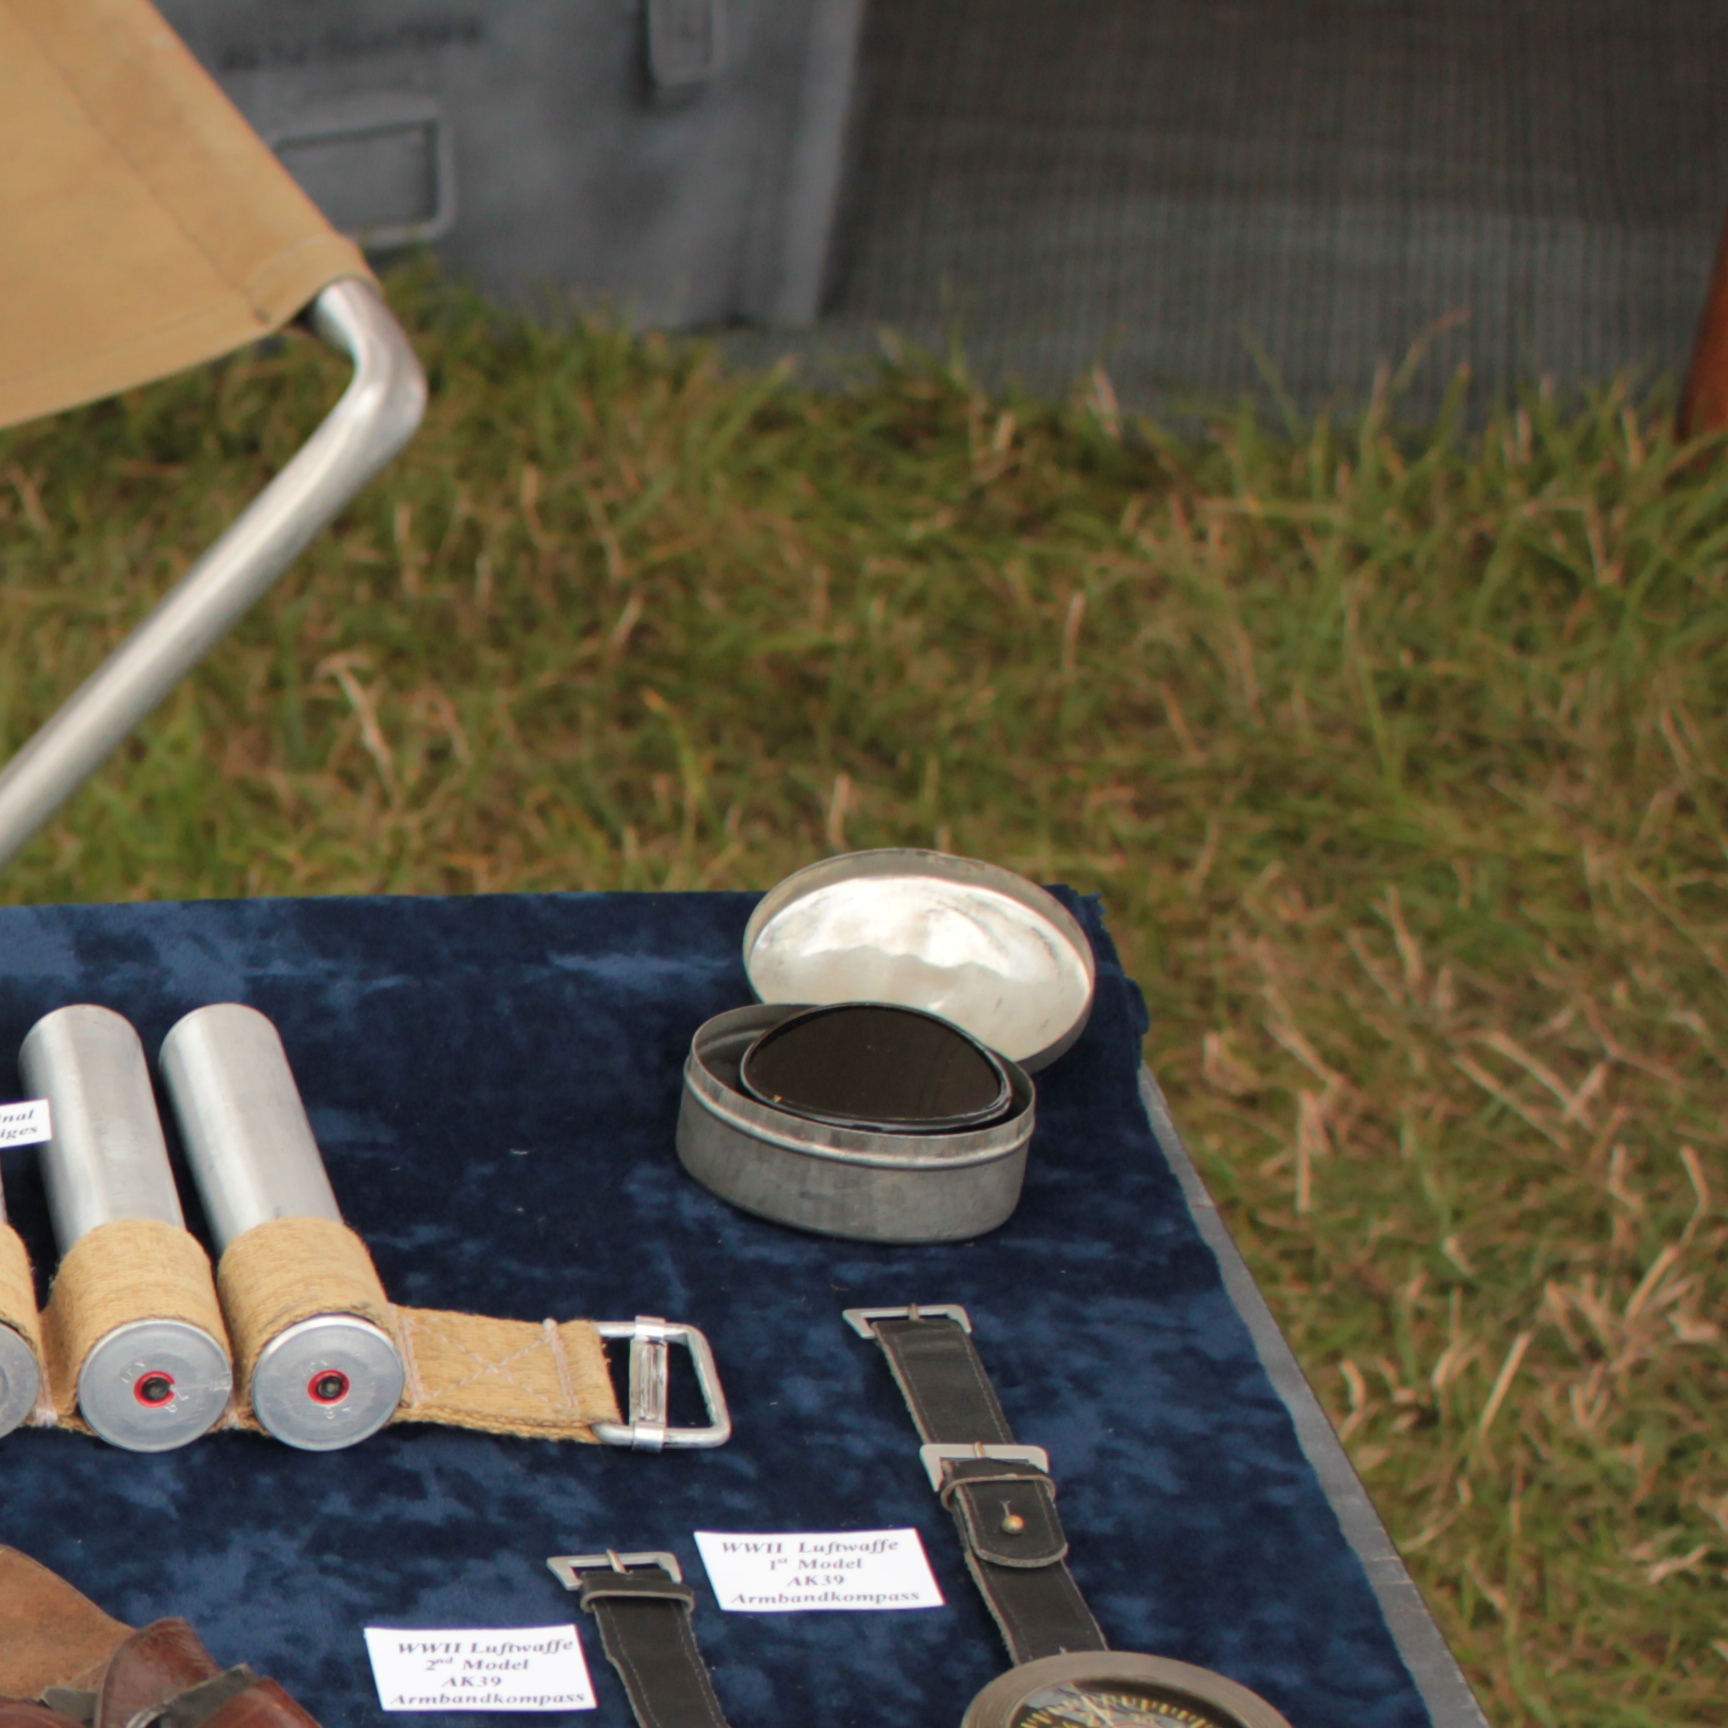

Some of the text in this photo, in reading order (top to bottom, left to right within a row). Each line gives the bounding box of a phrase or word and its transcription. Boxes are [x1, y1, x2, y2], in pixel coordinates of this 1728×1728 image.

[722, 1539, 899, 1556] WWII Luftwaffe
[798, 1558, 862, 1570] Model
[787, 1574, 845, 1587] AK39
[731, 1591, 921, 1605] Armbandkompass
[398, 1638, 574, 1656] WWII Luftwaffe
[463, 1659, 529, 1671] Model
[442, 1676, 502, 1688] AK39
[391, 1692, 586, 1706] Armbandkompass
